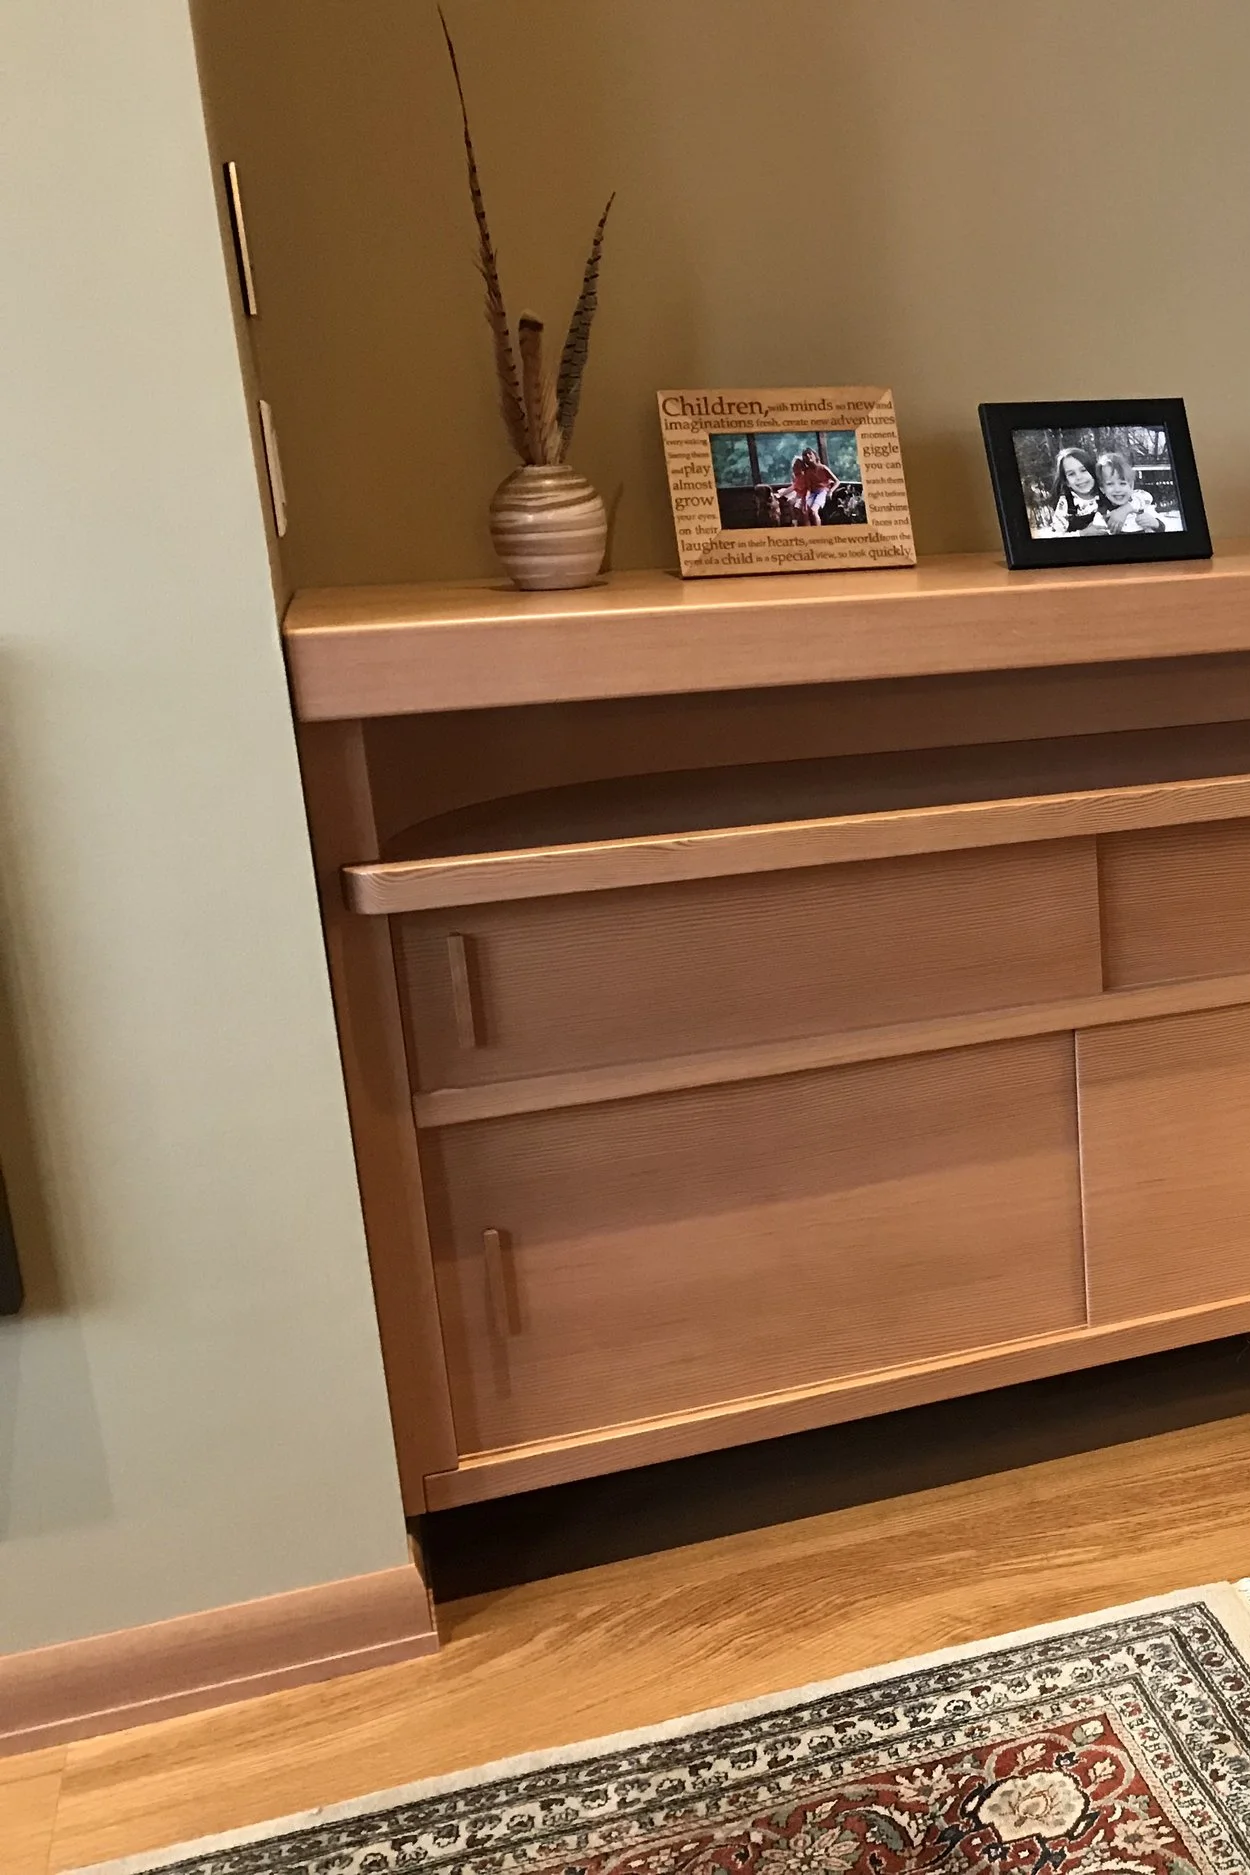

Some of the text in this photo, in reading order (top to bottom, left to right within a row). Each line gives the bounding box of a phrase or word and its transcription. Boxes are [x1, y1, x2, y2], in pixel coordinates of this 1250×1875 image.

[662, 396, 768, 417] Children,
[768, 403, 788, 412] with
[790, 398, 833, 412] minds
[847, 400, 875, 411] new
[876, 401, 892, 410] and
[664, 418, 754, 433] imaginations
[782, 419, 808, 427] create
[830, 415, 895, 426] adventures
[863, 442, 899, 458] giggle
[684, 462, 710, 478] play
[865, 463, 882, 473] you
[673, 479, 713, 491] almost
[866, 477, 886, 485] watch
[868, 491, 884, 499] right
[675, 496, 714, 511] grow
[869, 503, 908, 512] Sunshine
[677, 514, 696, 523] your
[872, 517, 909, 526] faces and
[695, 525, 718, 535] their
[681, 538, 735, 554] laughter
[767, 536, 807, 547] hearts,
[834, 535, 847, 544] the
[847, 532, 880, 544] world
[880, 534, 898, 542] from
[899, 532, 911, 540] the
[705, 557, 713, 565] of
[721, 553, 753, 565] child
[771, 549, 815, 566] special
[849, 549, 866, 558] look
